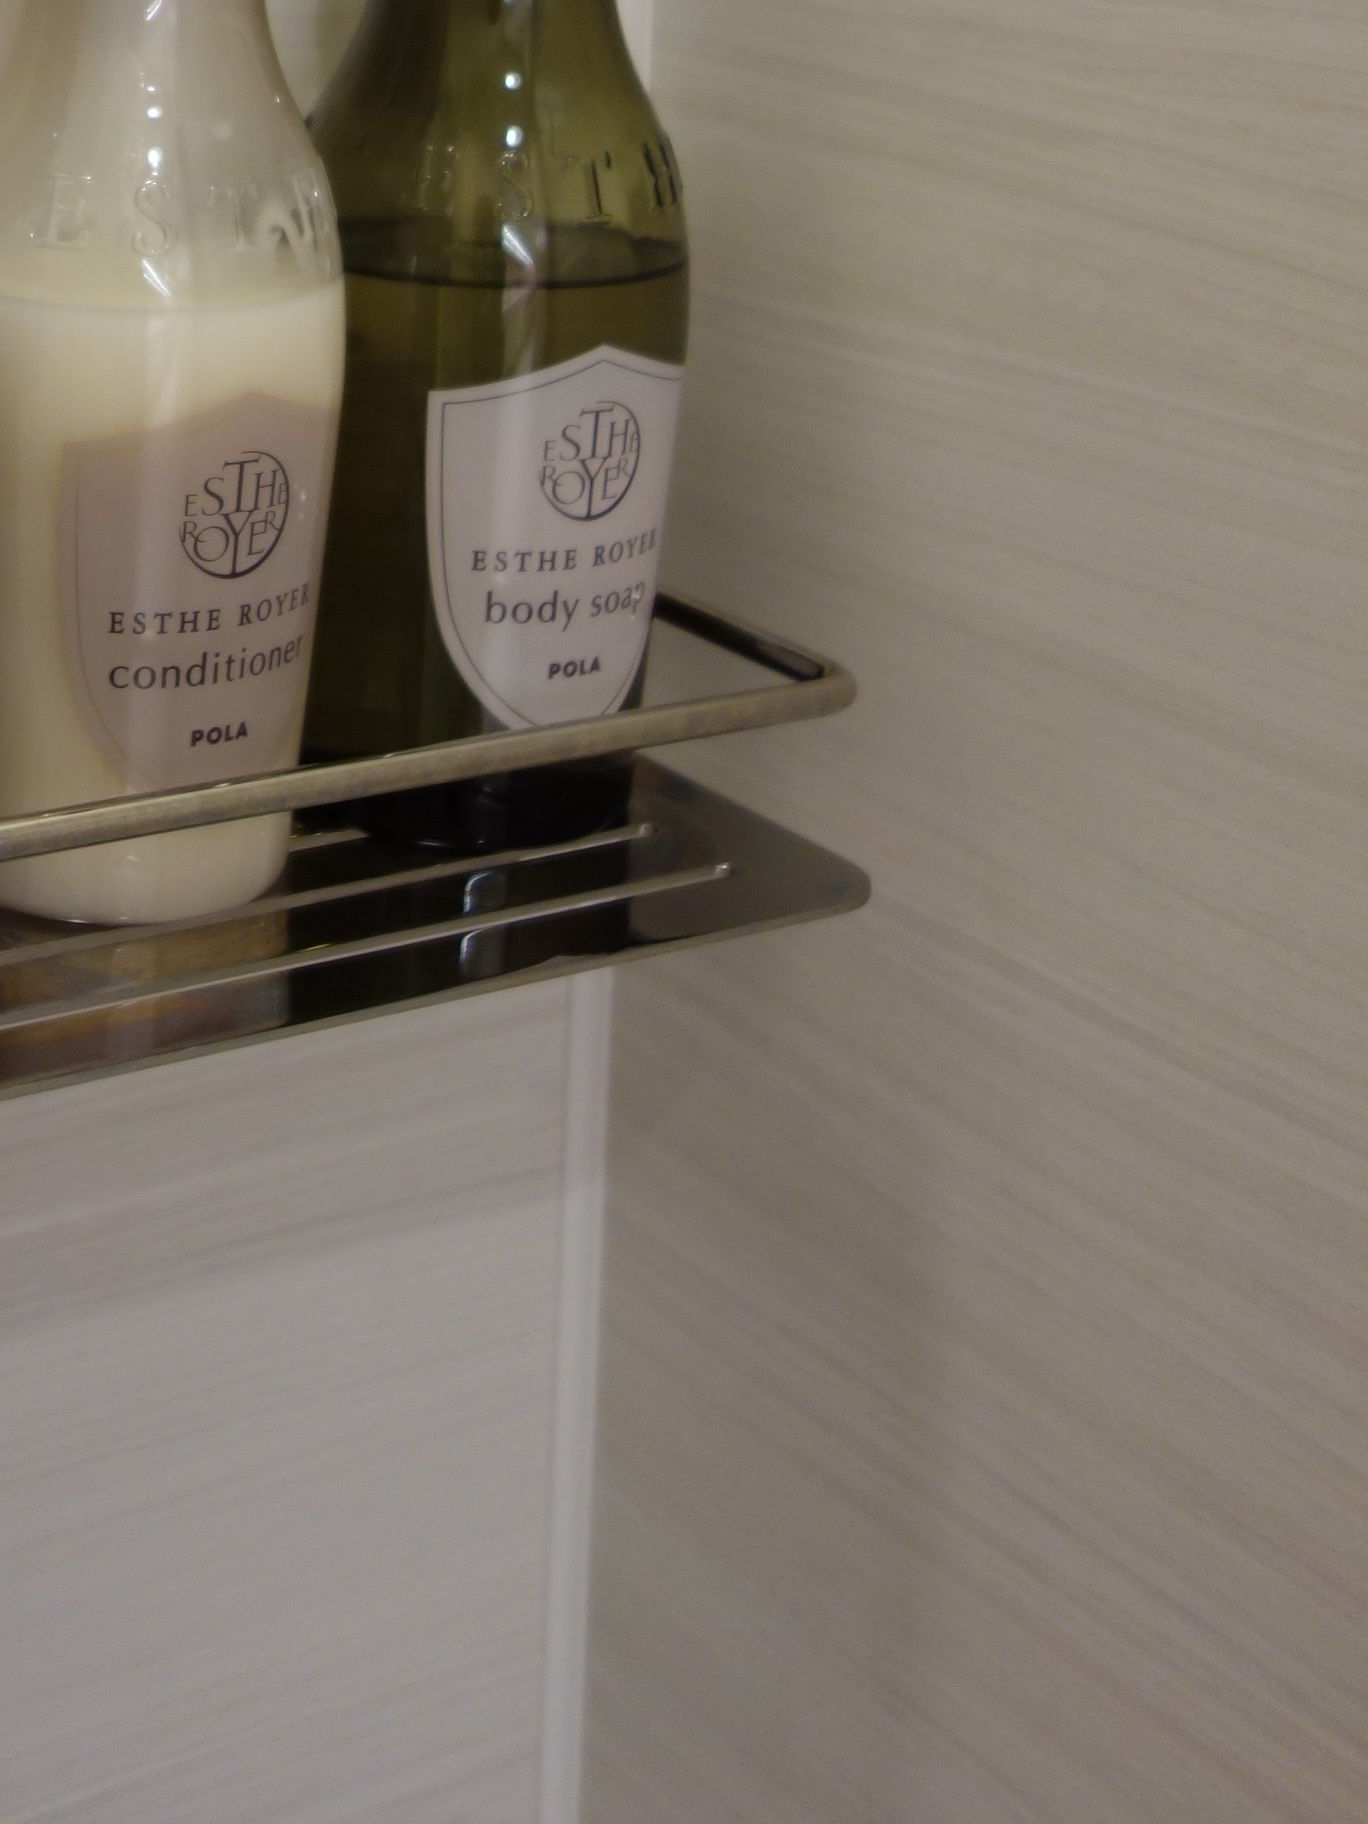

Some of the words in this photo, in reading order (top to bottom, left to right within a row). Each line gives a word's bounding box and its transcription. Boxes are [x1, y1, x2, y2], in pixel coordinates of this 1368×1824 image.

[471, 549, 577, 573] ESTHE
[108, 610, 222, 635] ESTHE
[237, 583, 310, 627] ROYER
[485, 590, 580, 632] body
[589, 582, 646, 618] soap
[109, 635, 304, 690] conditioner
[547, 657, 602, 679] POLA
[190, 721, 249, 747] POLA
